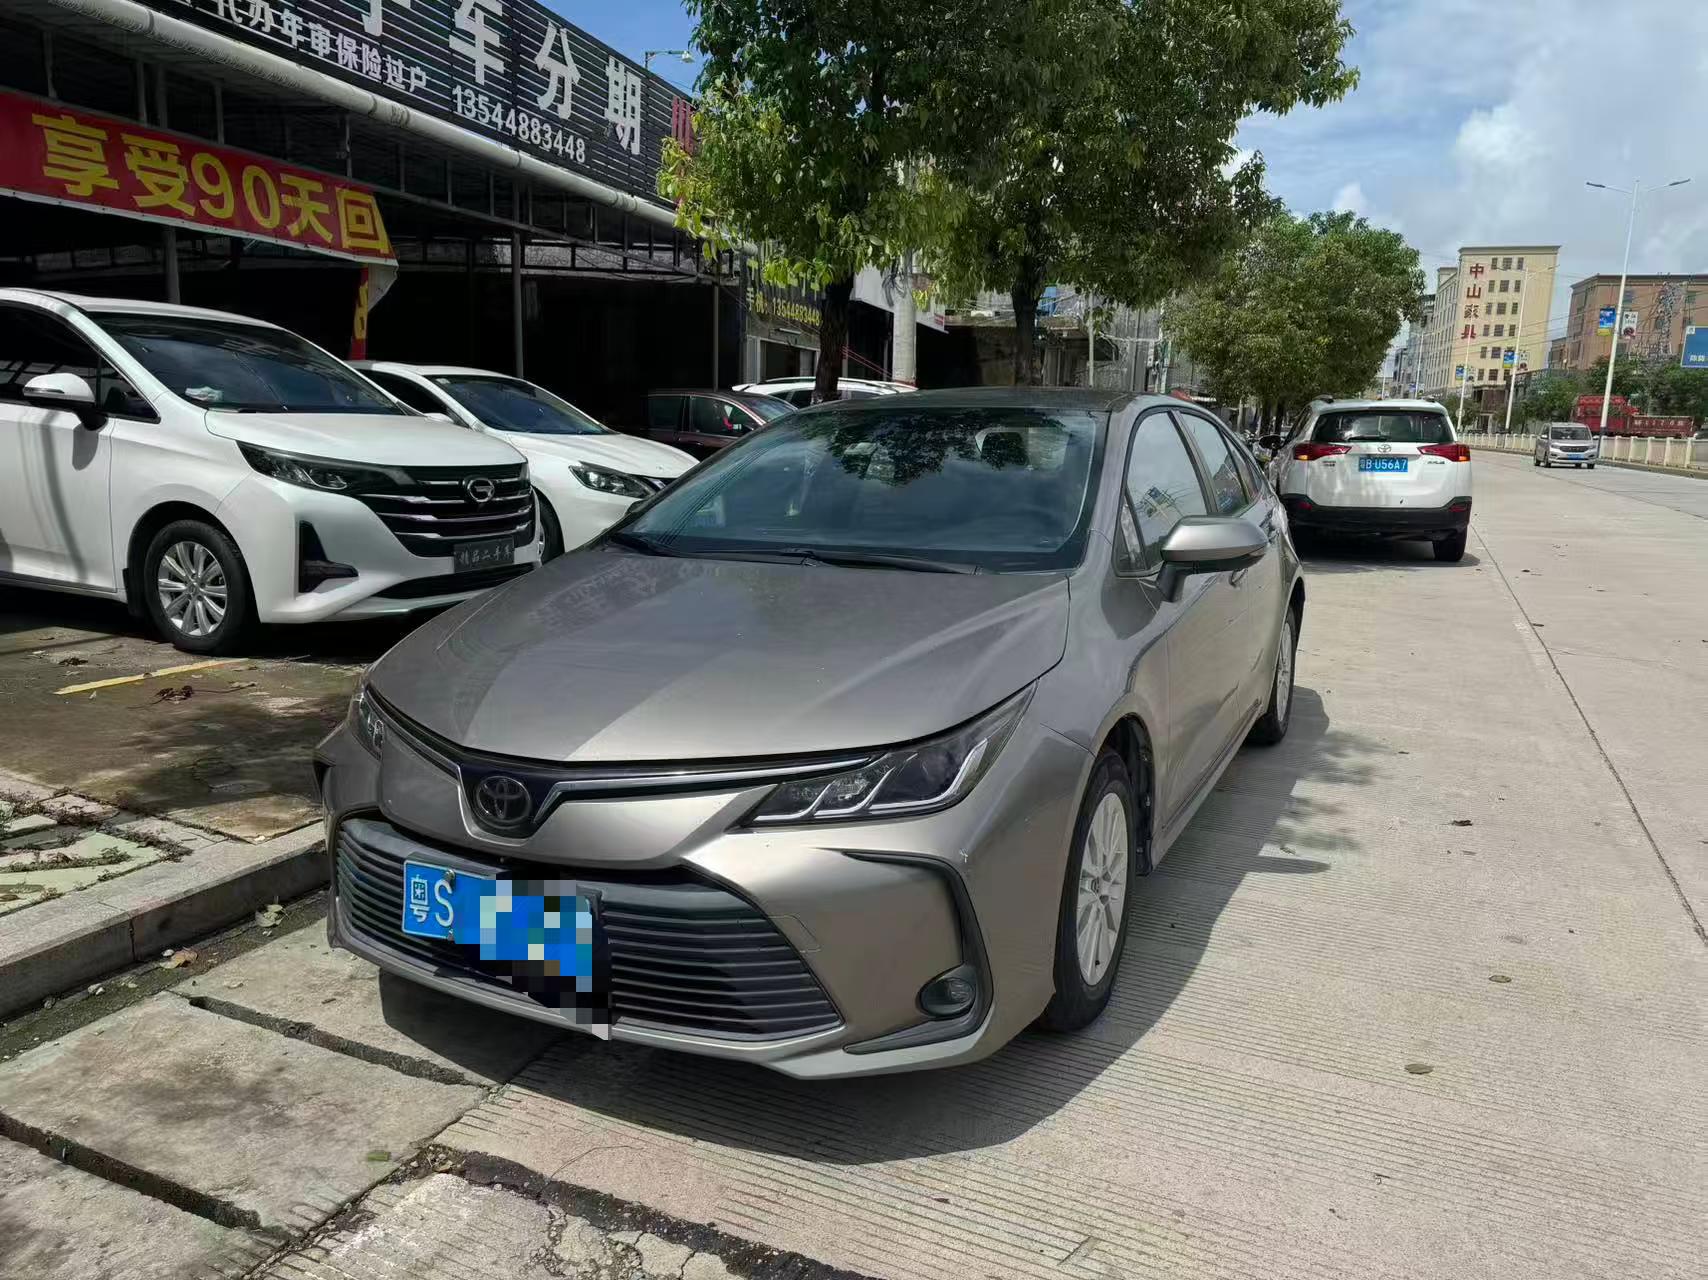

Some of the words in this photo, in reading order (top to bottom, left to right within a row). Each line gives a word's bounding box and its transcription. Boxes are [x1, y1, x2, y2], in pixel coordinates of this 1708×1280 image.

[452, 86, 586, 163] 13544883448
[32, 113, 389, 254] 享受90天回
